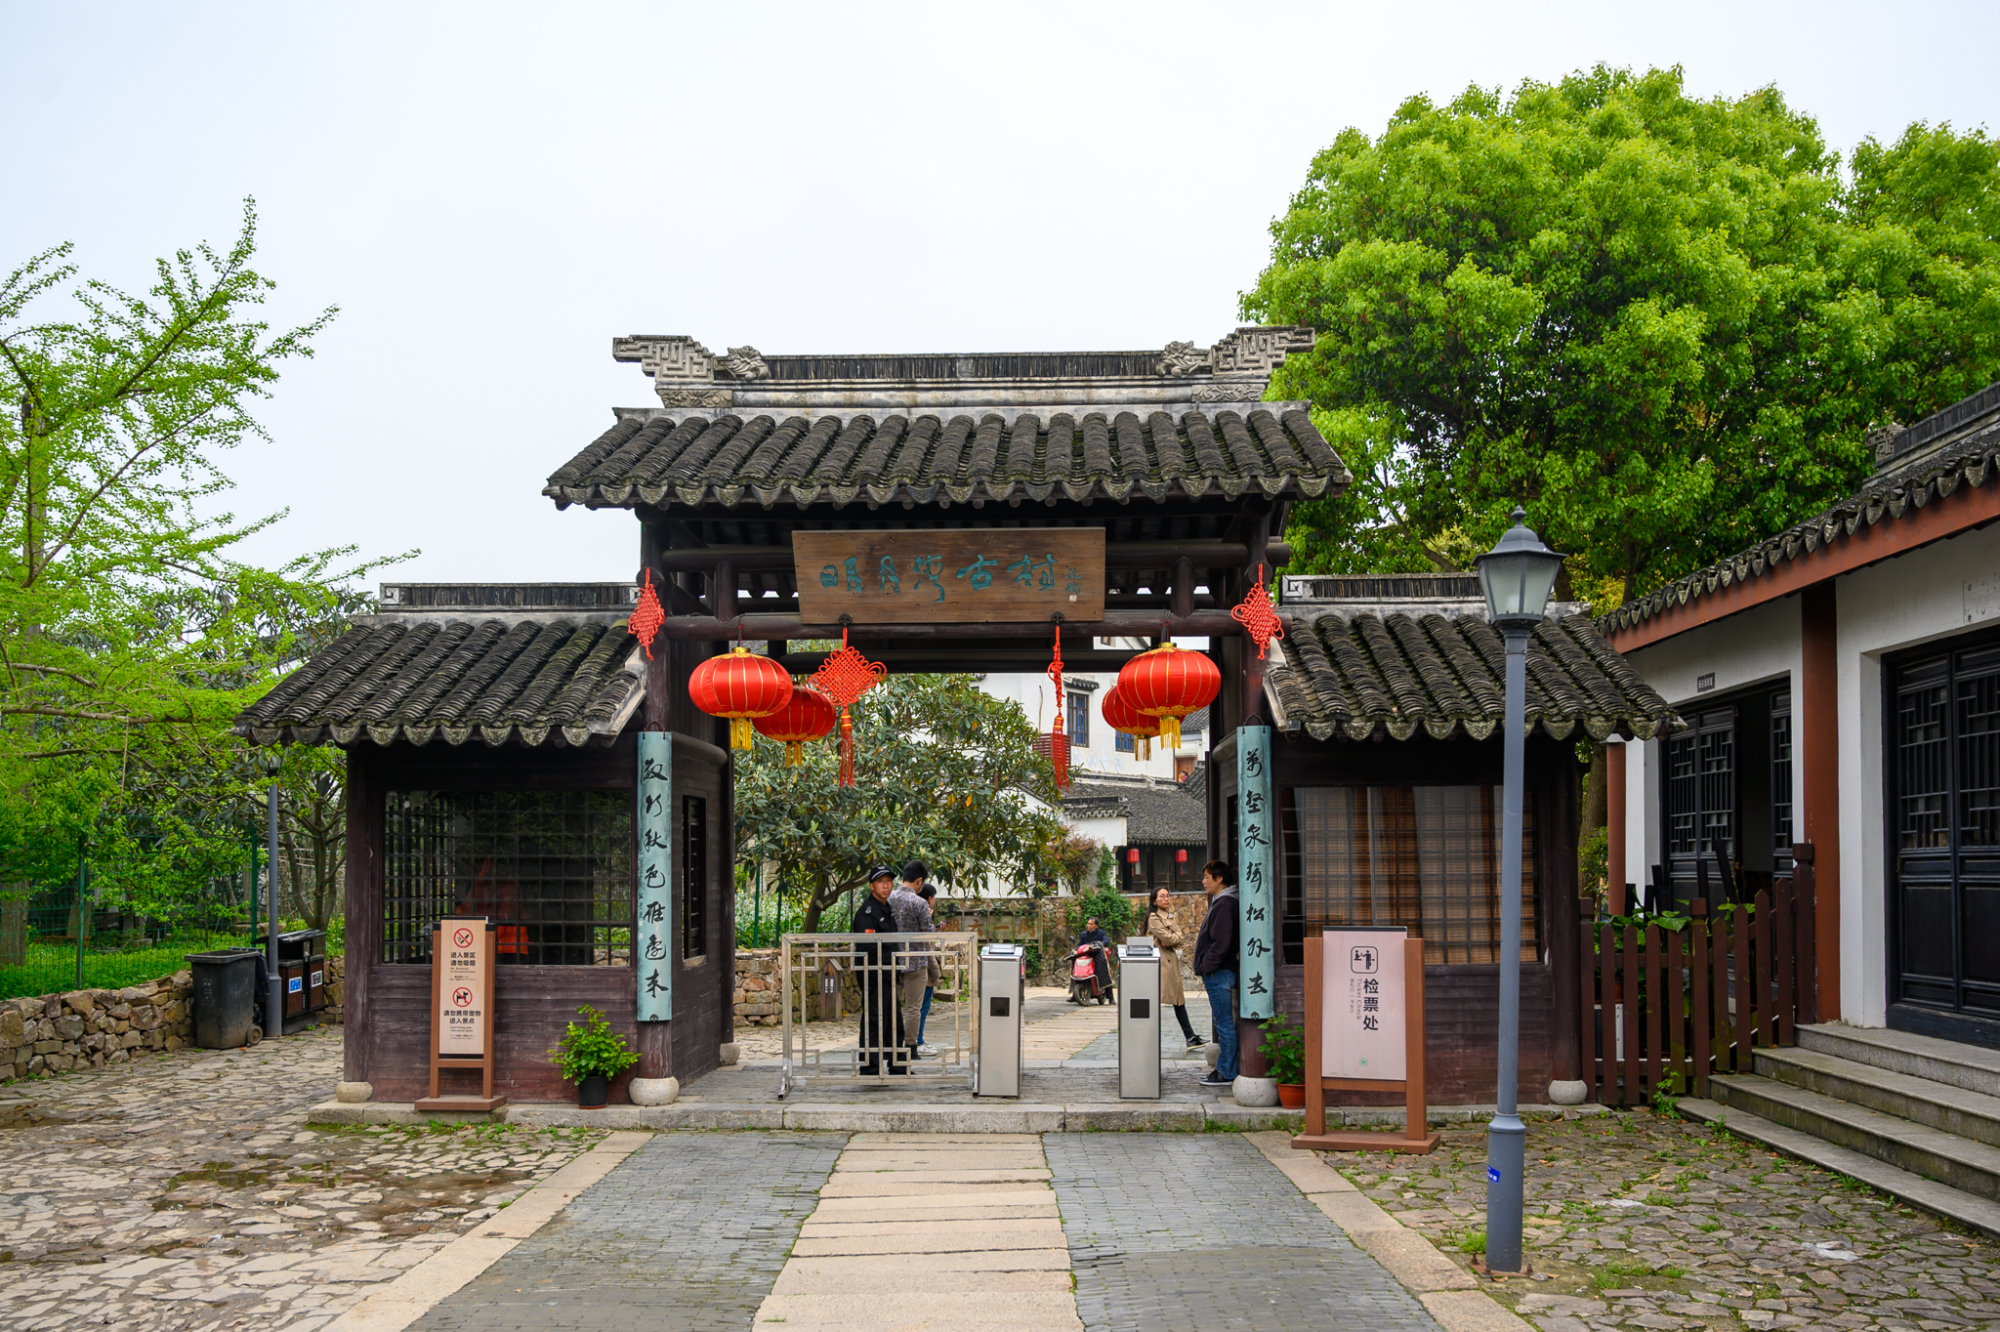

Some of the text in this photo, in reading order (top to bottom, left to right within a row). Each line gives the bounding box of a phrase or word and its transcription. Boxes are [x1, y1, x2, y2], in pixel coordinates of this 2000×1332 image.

[450, 951, 476, 959] 进入景区
[450, 959, 476, 967] 请勿吸烟
[1363, 978, 1379, 1031] 检票处
